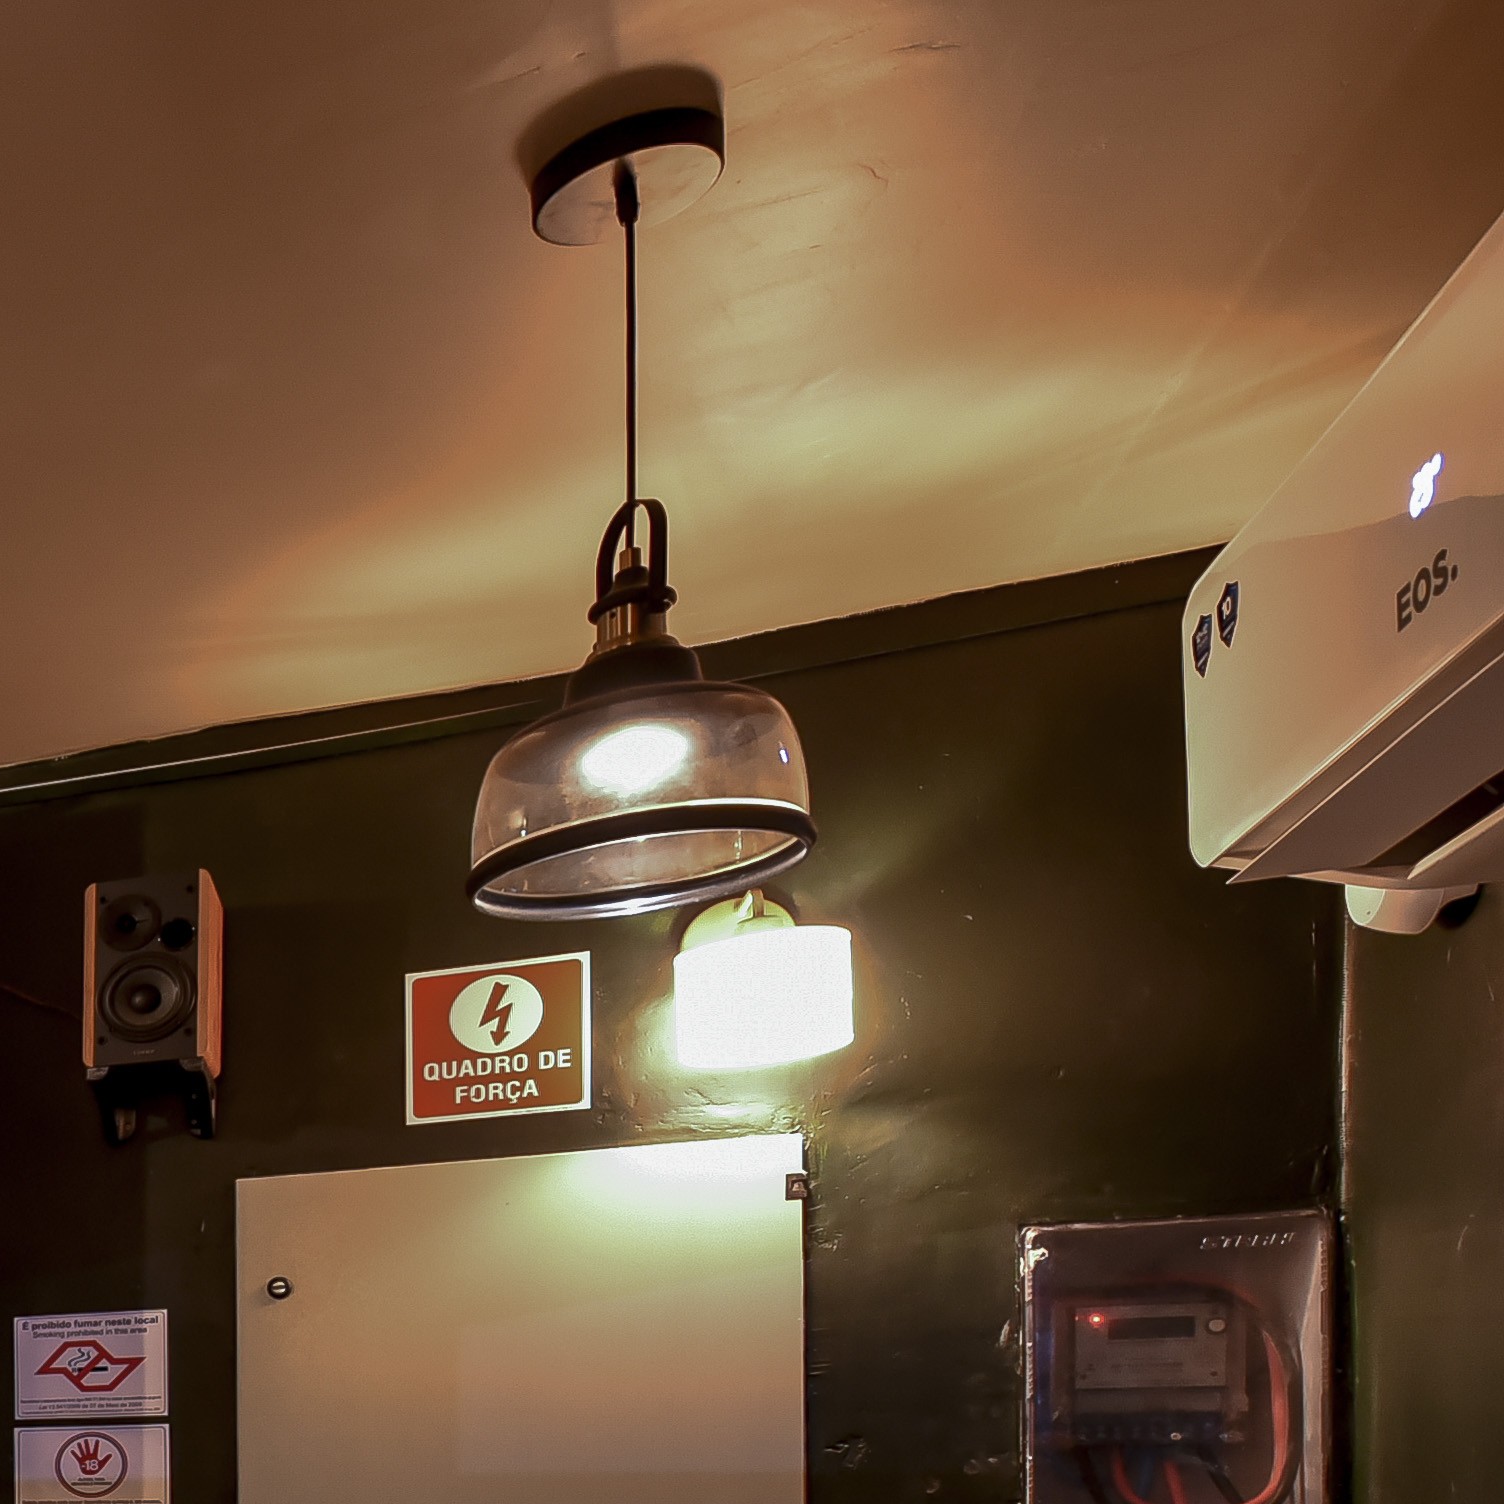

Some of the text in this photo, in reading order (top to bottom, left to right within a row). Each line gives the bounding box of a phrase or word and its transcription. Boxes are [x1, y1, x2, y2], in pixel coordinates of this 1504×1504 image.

[423, 1048, 572, 1081] QUADRO DE
[455, 1079, 539, 1104] FORÇA
[22, 1316, 159, 1331] É proibido fumar neste local
